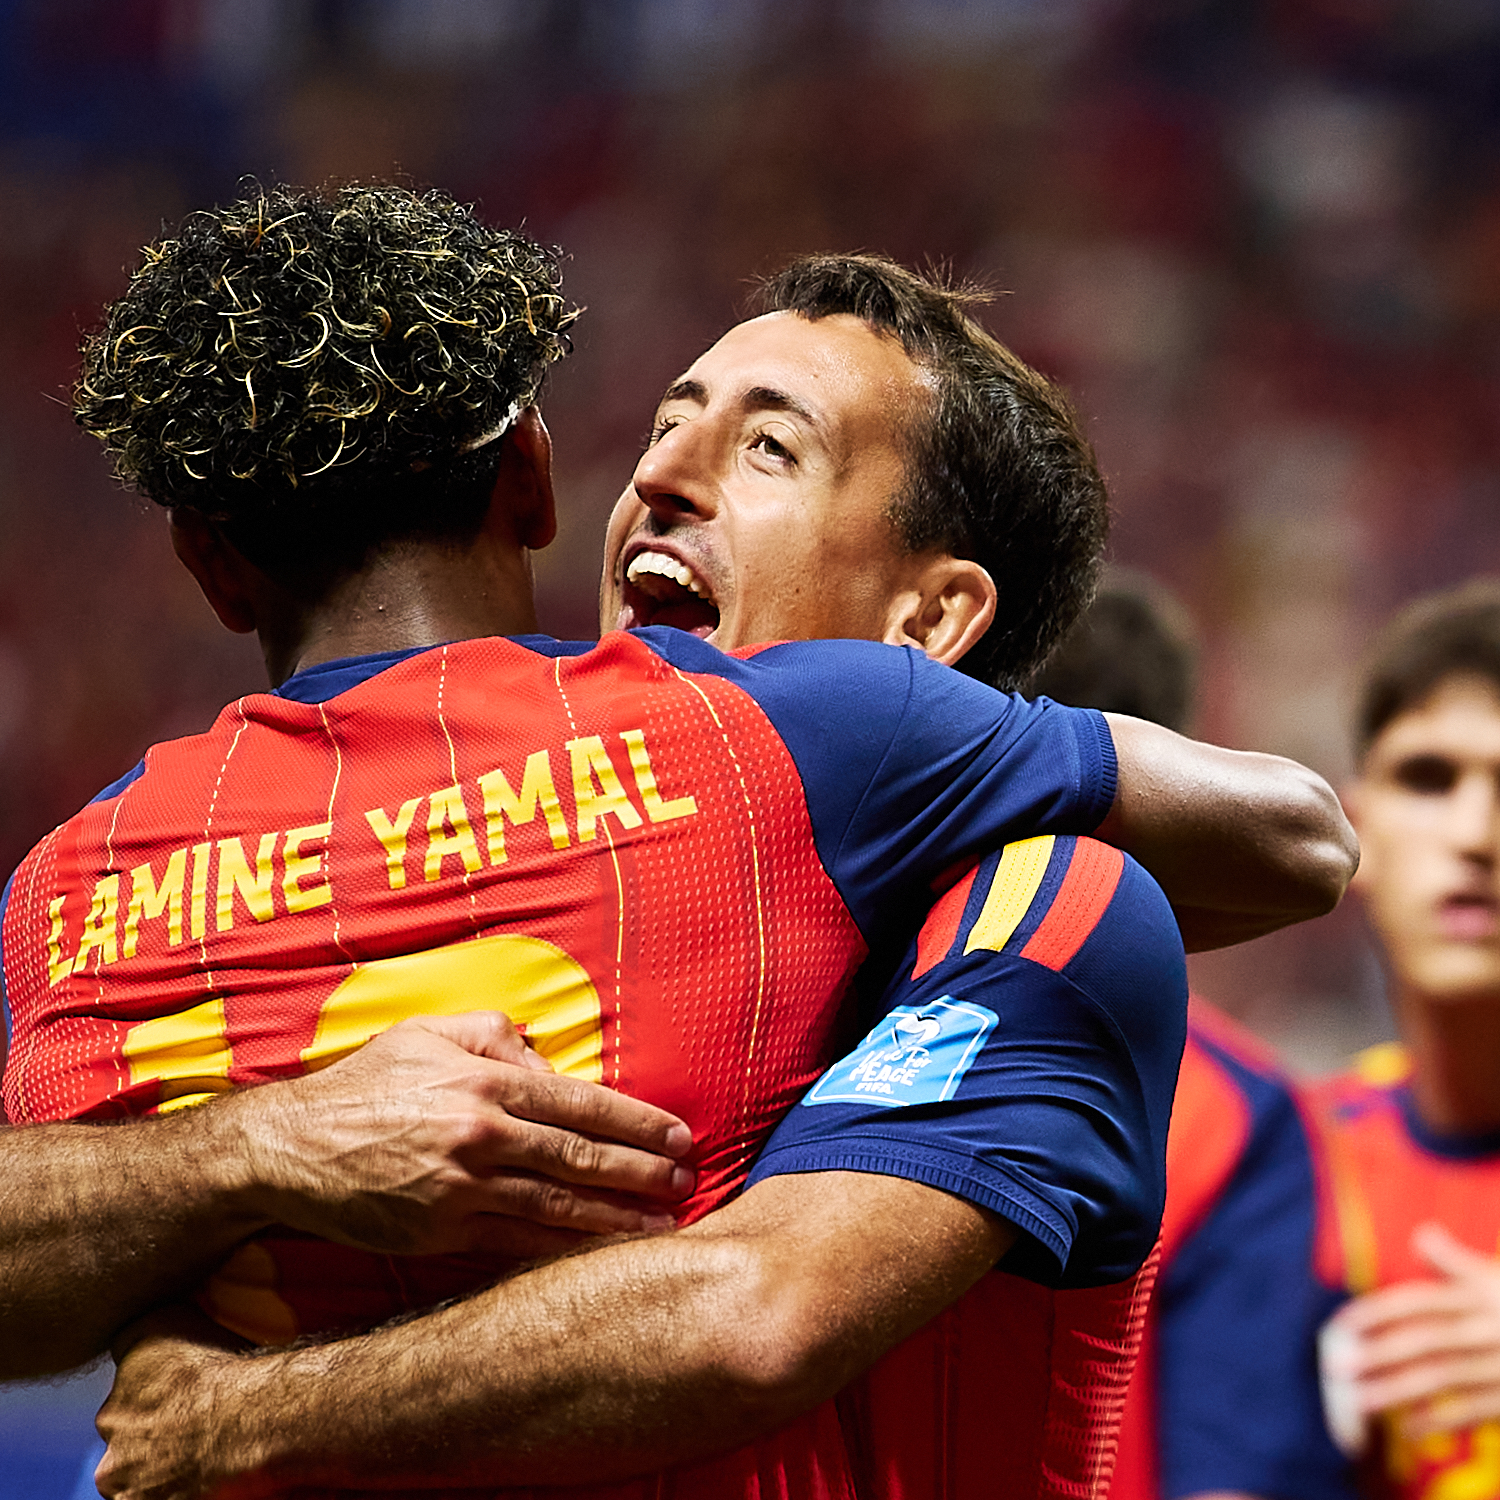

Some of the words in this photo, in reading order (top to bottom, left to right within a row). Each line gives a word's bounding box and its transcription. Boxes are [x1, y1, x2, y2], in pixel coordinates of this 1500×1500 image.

[47, 823, 332, 988] LAMINE
[365, 728, 698, 890] YAMAL
[849, 1061, 920, 1086] PEACE
